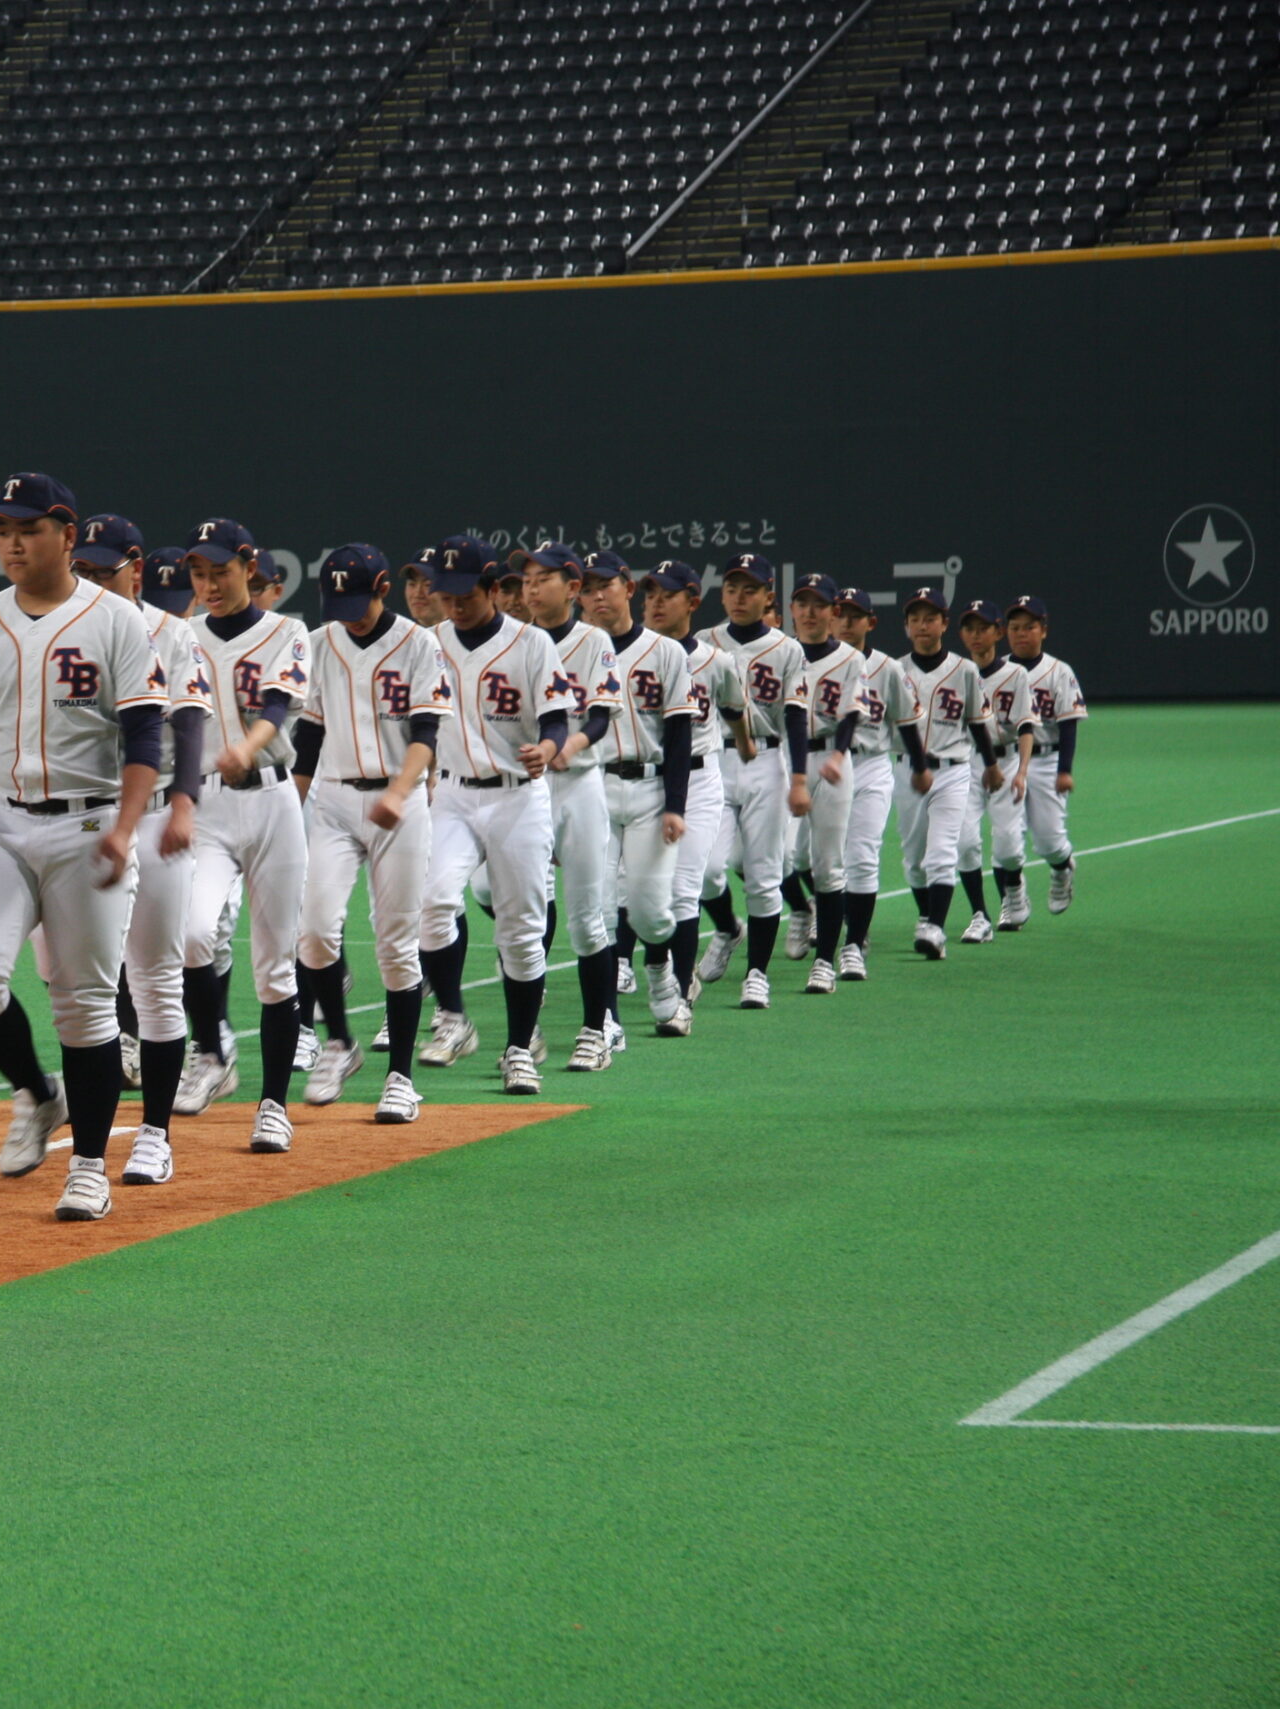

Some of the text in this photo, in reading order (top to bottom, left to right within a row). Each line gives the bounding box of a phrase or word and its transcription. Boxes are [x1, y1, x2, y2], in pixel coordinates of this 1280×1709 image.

[3, 478, 21, 501] T
[85, 521, 104, 543] T
[197, 522, 215, 541] T
[419, 548, 436, 562] T
[443, 550, 460, 569] T
[583, 552, 599, 568] T
[739, 553, 755, 568] T
[158, 565, 175, 586] T
[657, 560, 673, 574] T
[331, 571, 348, 592] T
[1149, 607, 1270, 636] SAPPORO
[50, 647, 100, 698] TB
[750, 662, 781, 702] TB
[375, 669, 411, 715] TB
[481, 671, 522, 715] TB
[630, 669, 662, 710] TB
[937, 687, 964, 721] TB
